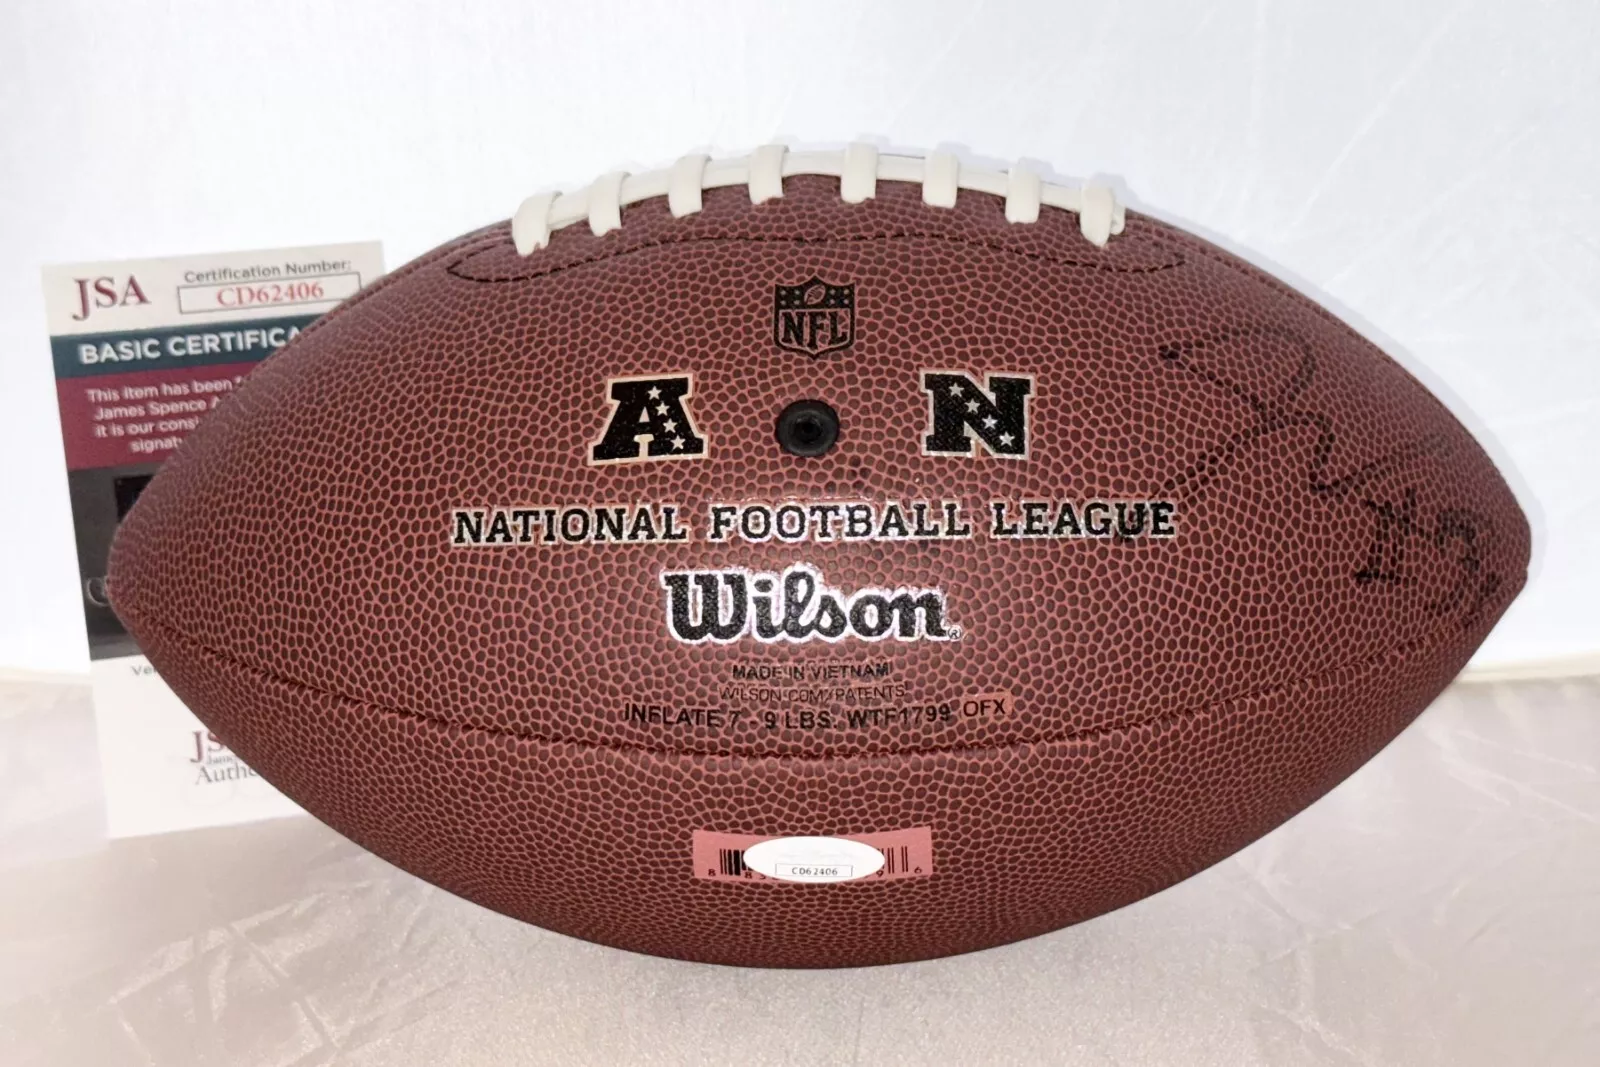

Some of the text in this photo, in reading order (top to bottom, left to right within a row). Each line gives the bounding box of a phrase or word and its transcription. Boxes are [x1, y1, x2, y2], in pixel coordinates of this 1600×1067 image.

[184, 259, 351, 283] Certification Number:
[70, 275, 151, 321] JSA
[217, 281, 324, 307] CD62406
[781, 310, 848, 349] NFL
[80, 338, 161, 364] BASIC
[86, 388, 120, 402] This
[161, 382, 190, 396] has
[193, 379, 233, 393] been
[95, 406, 145, 420] James
[148, 400, 207, 415] Spence
[588, 373, 709, 466] A
[920, 368, 1035, 459] N
[111, 423, 125, 436] is
[127, 423, 155, 435] our
[450, 499, 1179, 546] NATIONAL FOOTBALL LEAGUE
[732, 662, 893, 680] MADE IN VIETNAM
[718, 684, 905, 702] WILSON.COM/PATENTS
[624, 702, 720, 728] INFLATE
[728, 710, 742, 729] 7
[764, 711, 776, 730] 9
[785, 710, 838, 730] LBS.
[847, 703, 950, 728] WTF1799
[963, 699, 1006, 718] OFX
[708, 866, 922, 877] 8 6
[791, 867, 839, 876] CD62406
